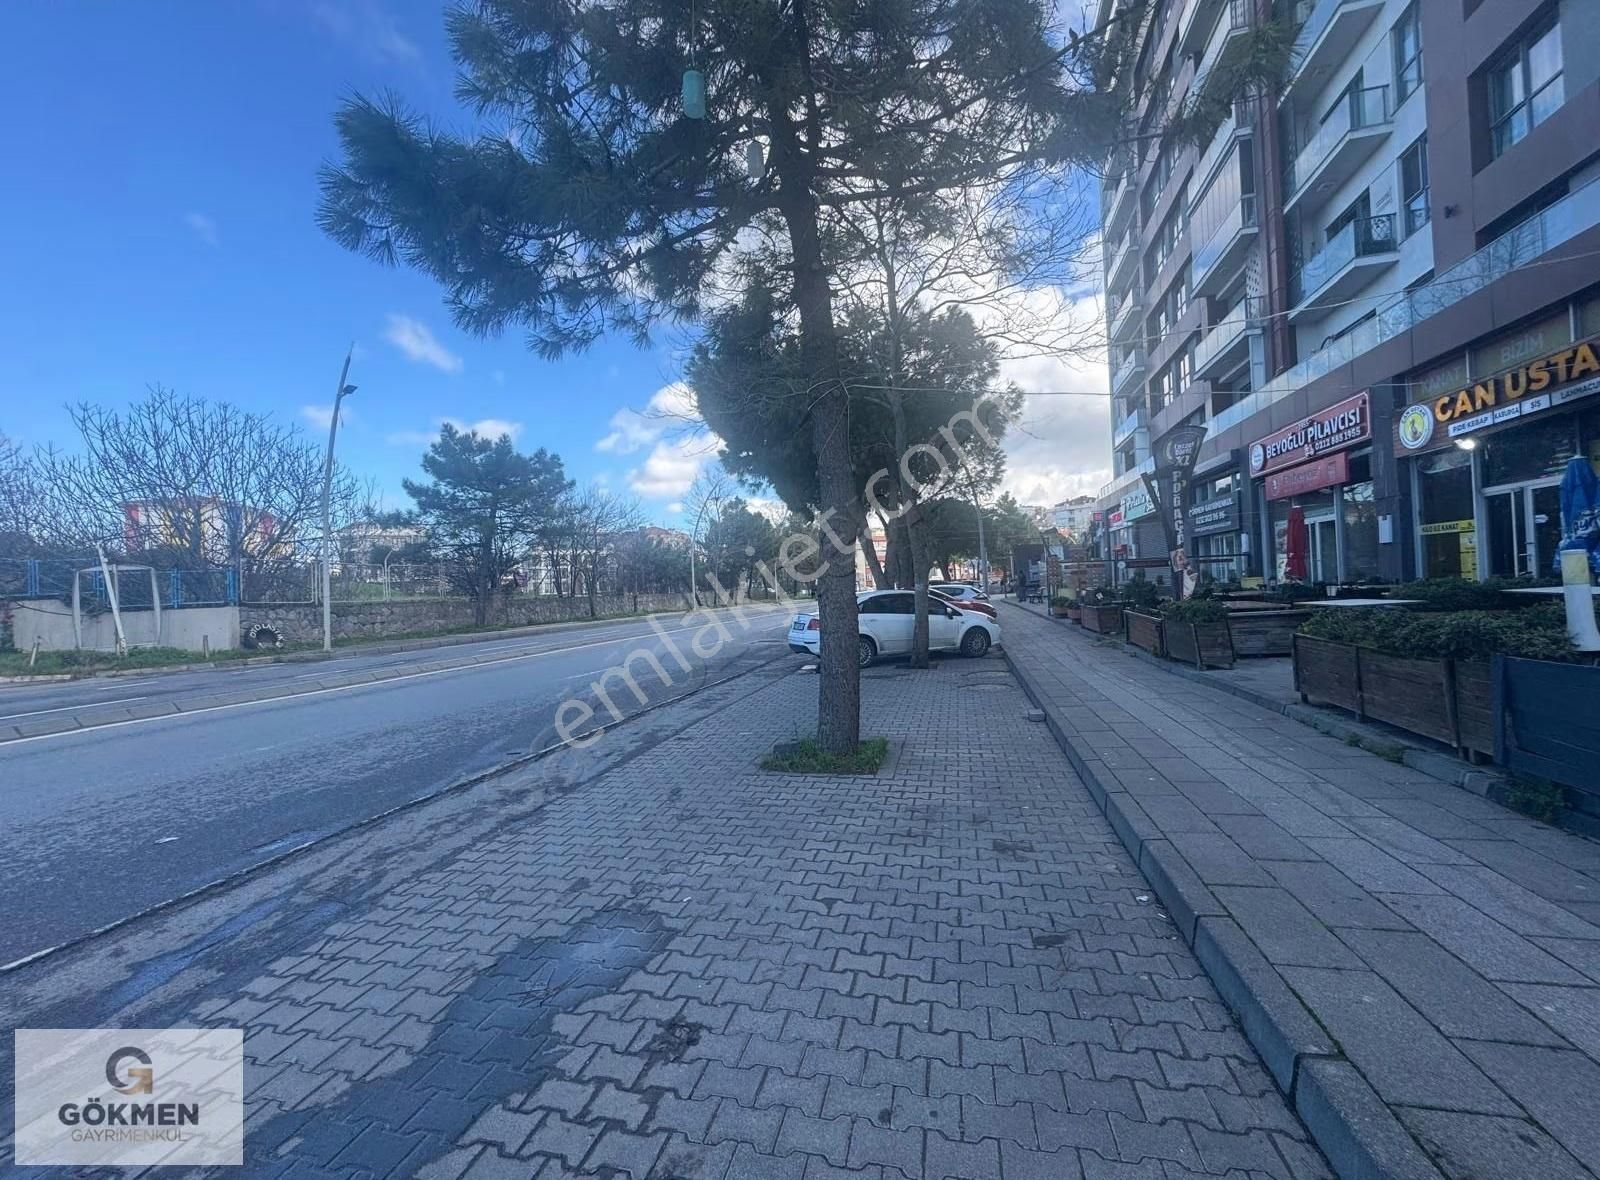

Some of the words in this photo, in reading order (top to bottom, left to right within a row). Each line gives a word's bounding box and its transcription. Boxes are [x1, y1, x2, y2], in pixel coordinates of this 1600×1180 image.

[1434, 379, 1496, 422] CAN
[1505, 343, 1600, 399] USTA
[1266, 431, 1305, 459] BEYOĞLU
[1307, 407, 1360, 443] PİLAVCISI
[1344, 426, 1361, 440] 1955
